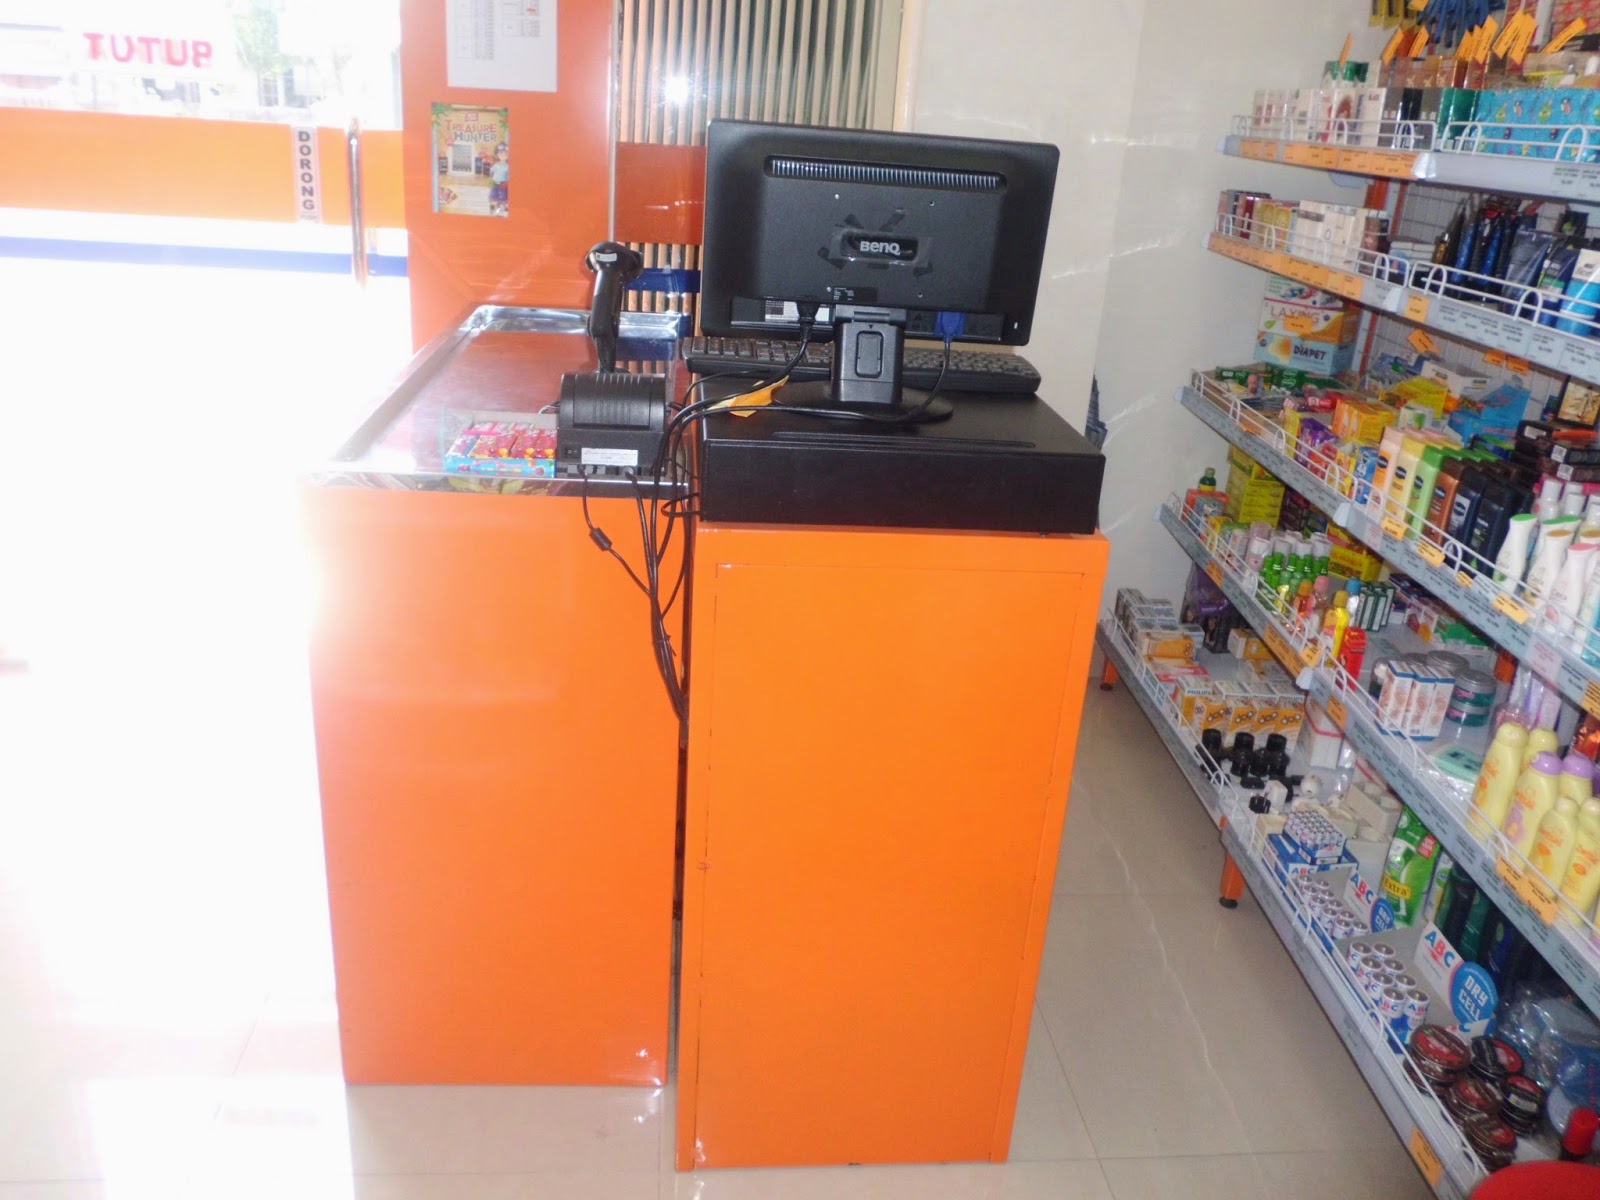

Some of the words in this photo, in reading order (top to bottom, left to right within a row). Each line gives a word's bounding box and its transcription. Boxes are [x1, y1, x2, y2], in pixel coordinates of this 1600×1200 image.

[83, 31, 212, 69] TUTUP
[445, 119, 497, 133] TREASURE
[454, 131, 497, 142] HUNTER
[297, 130, 316, 211] DORONG
[859, 240, 901, 256] BenQ
[1293, 345, 1327, 360] DIAPET
[1291, 867, 1314, 875] ABC
[1350, 873, 1374, 904] ABC
[1424, 930, 1456, 969] ABC
[1464, 975, 1489, 1008] DRY
